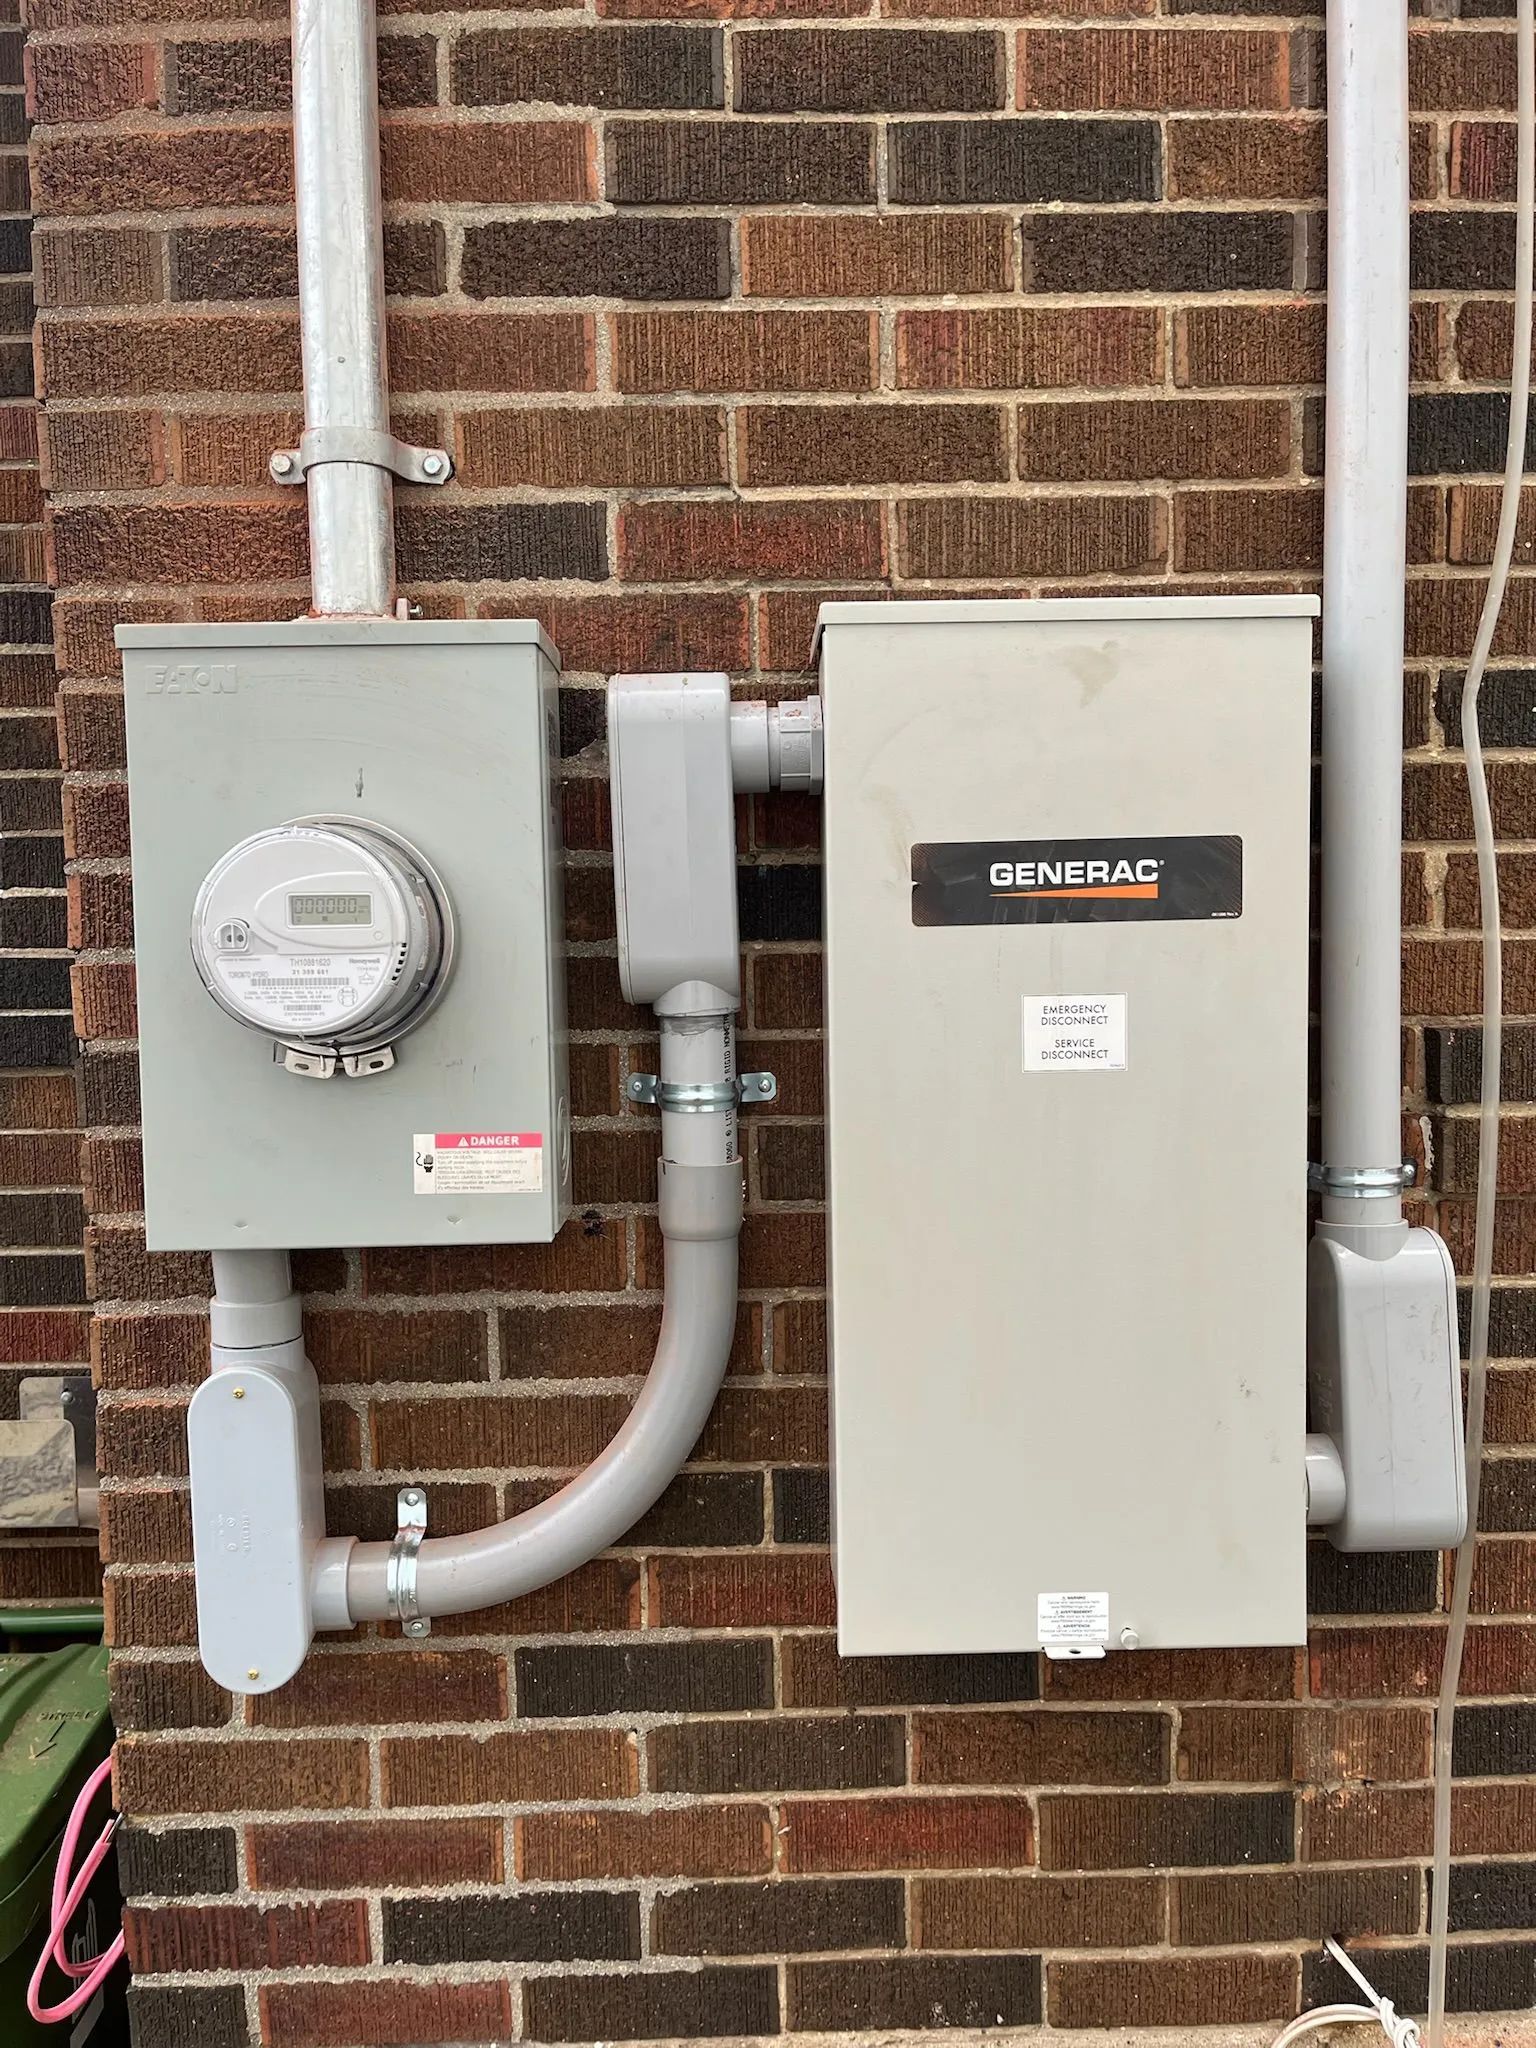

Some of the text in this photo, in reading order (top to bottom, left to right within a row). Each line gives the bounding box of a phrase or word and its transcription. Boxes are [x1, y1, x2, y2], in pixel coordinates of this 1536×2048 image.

[144, 663, 238, 695] EATON
[989, 858, 1159, 887] GENERAC
[1043, 1004, 1107, 1015] EMERGENCY
[1041, 1015, 1108, 1026] DISCONNECT
[1054, 1038, 1095, 1048] SERVICE
[1041, 1049, 1109, 1060] DISCONNECT
[470, 1135, 519, 1146] DANGER
